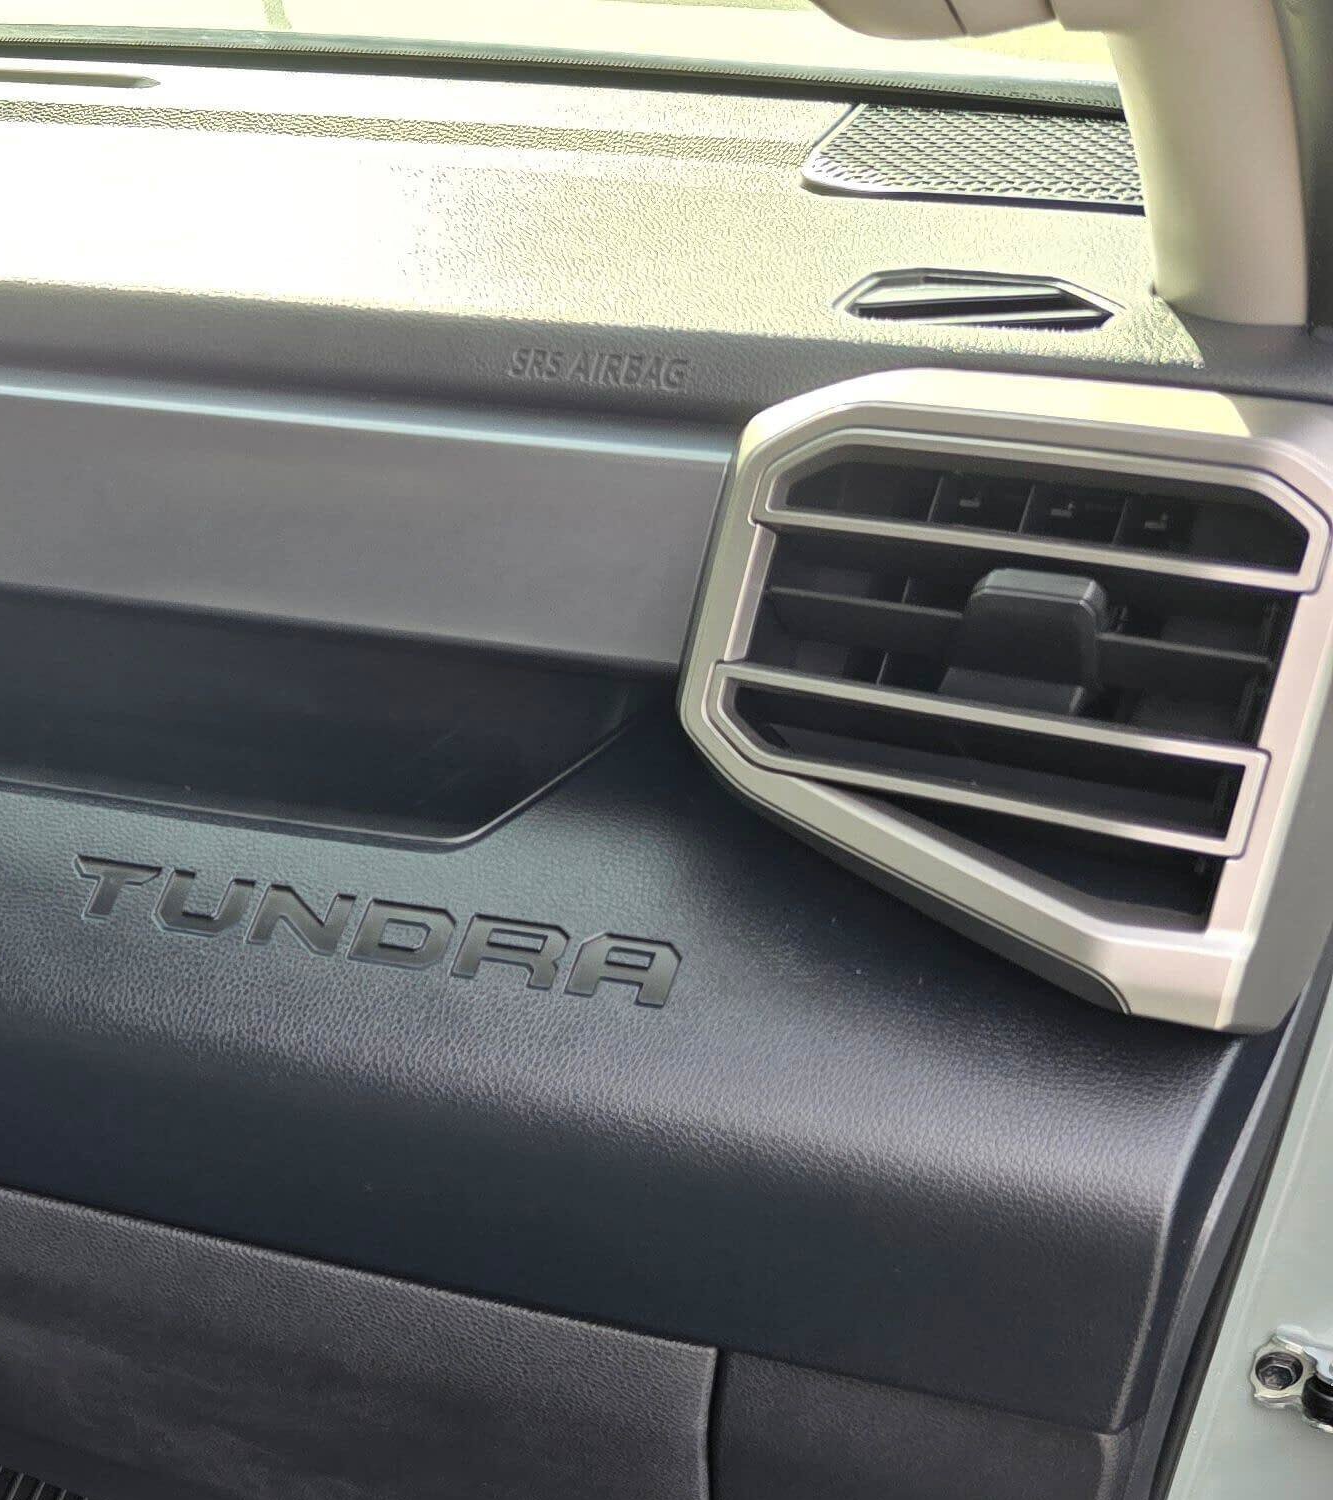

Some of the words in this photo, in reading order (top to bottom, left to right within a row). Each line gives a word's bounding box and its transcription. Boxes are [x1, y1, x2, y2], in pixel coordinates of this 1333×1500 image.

[507, 348, 562, 382] SRS
[564, 350, 690, 392] AIRBAG
[73, 854, 683, 1008] TUNDRA
